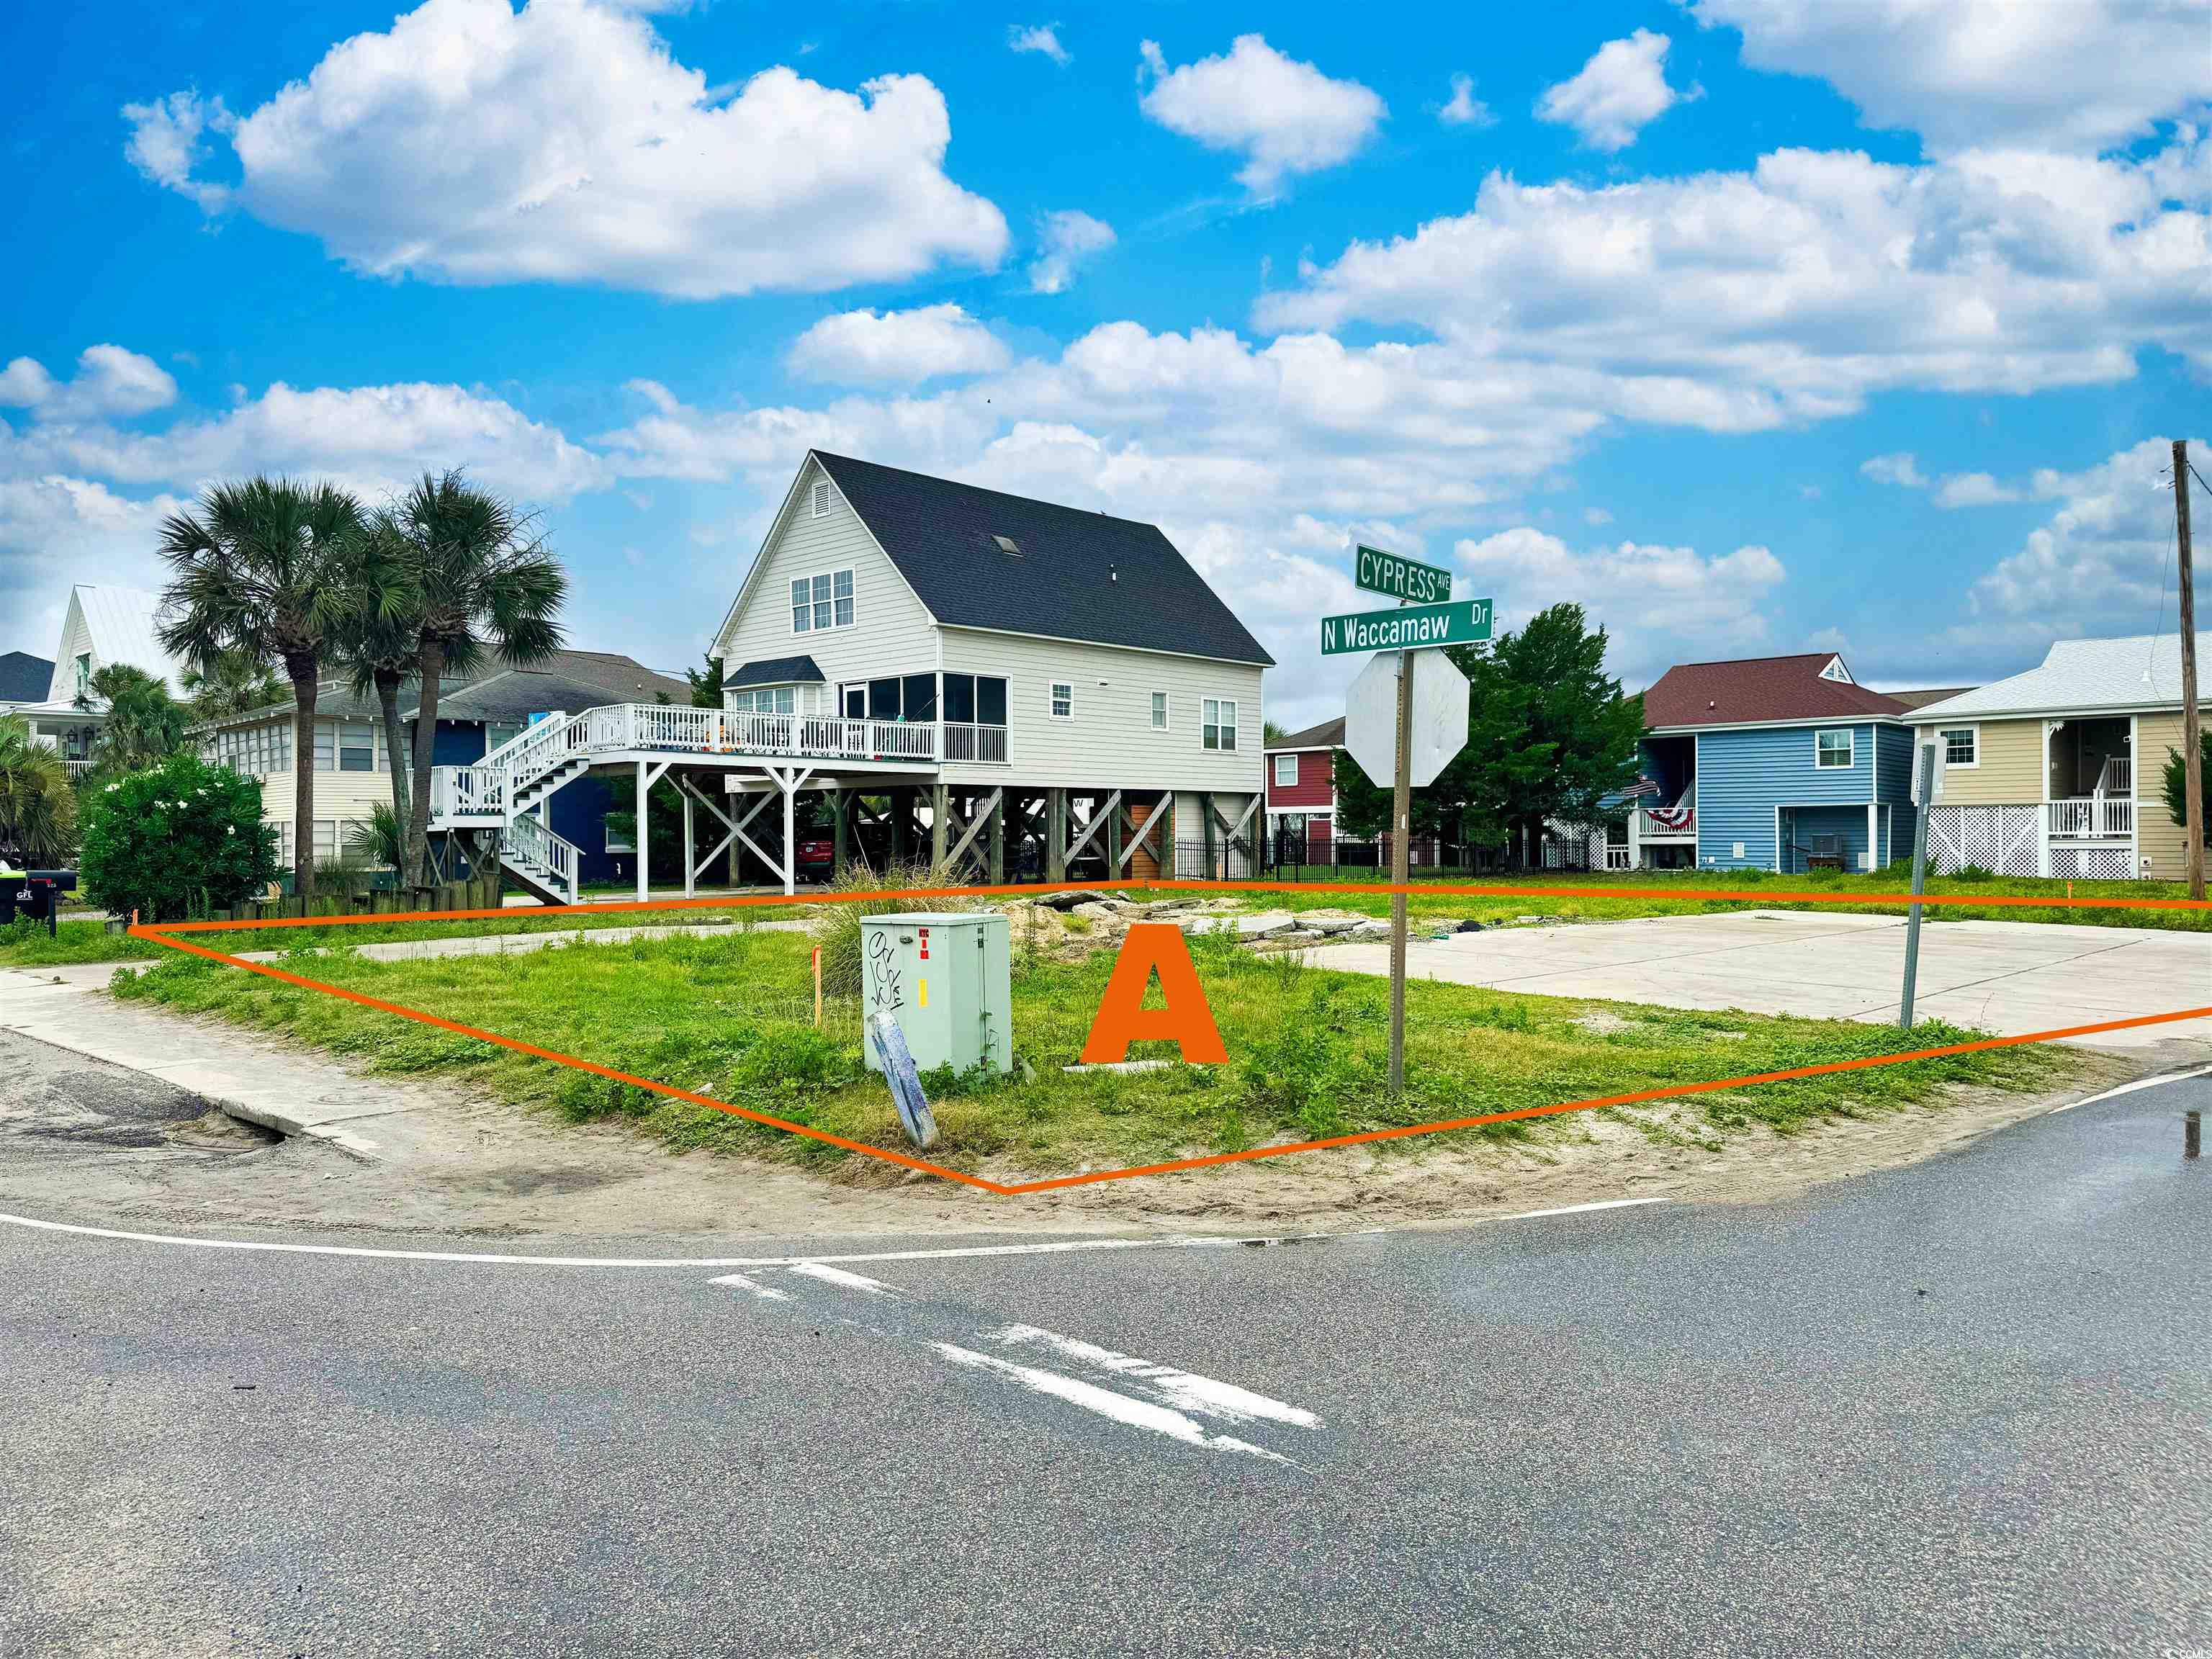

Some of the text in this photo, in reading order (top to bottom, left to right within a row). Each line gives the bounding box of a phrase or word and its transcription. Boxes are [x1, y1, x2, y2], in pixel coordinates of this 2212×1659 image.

[1360, 552, 1450, 602] CYPRESS AVE
[1325, 603, 1488, 650] N Waccamaw Dr
